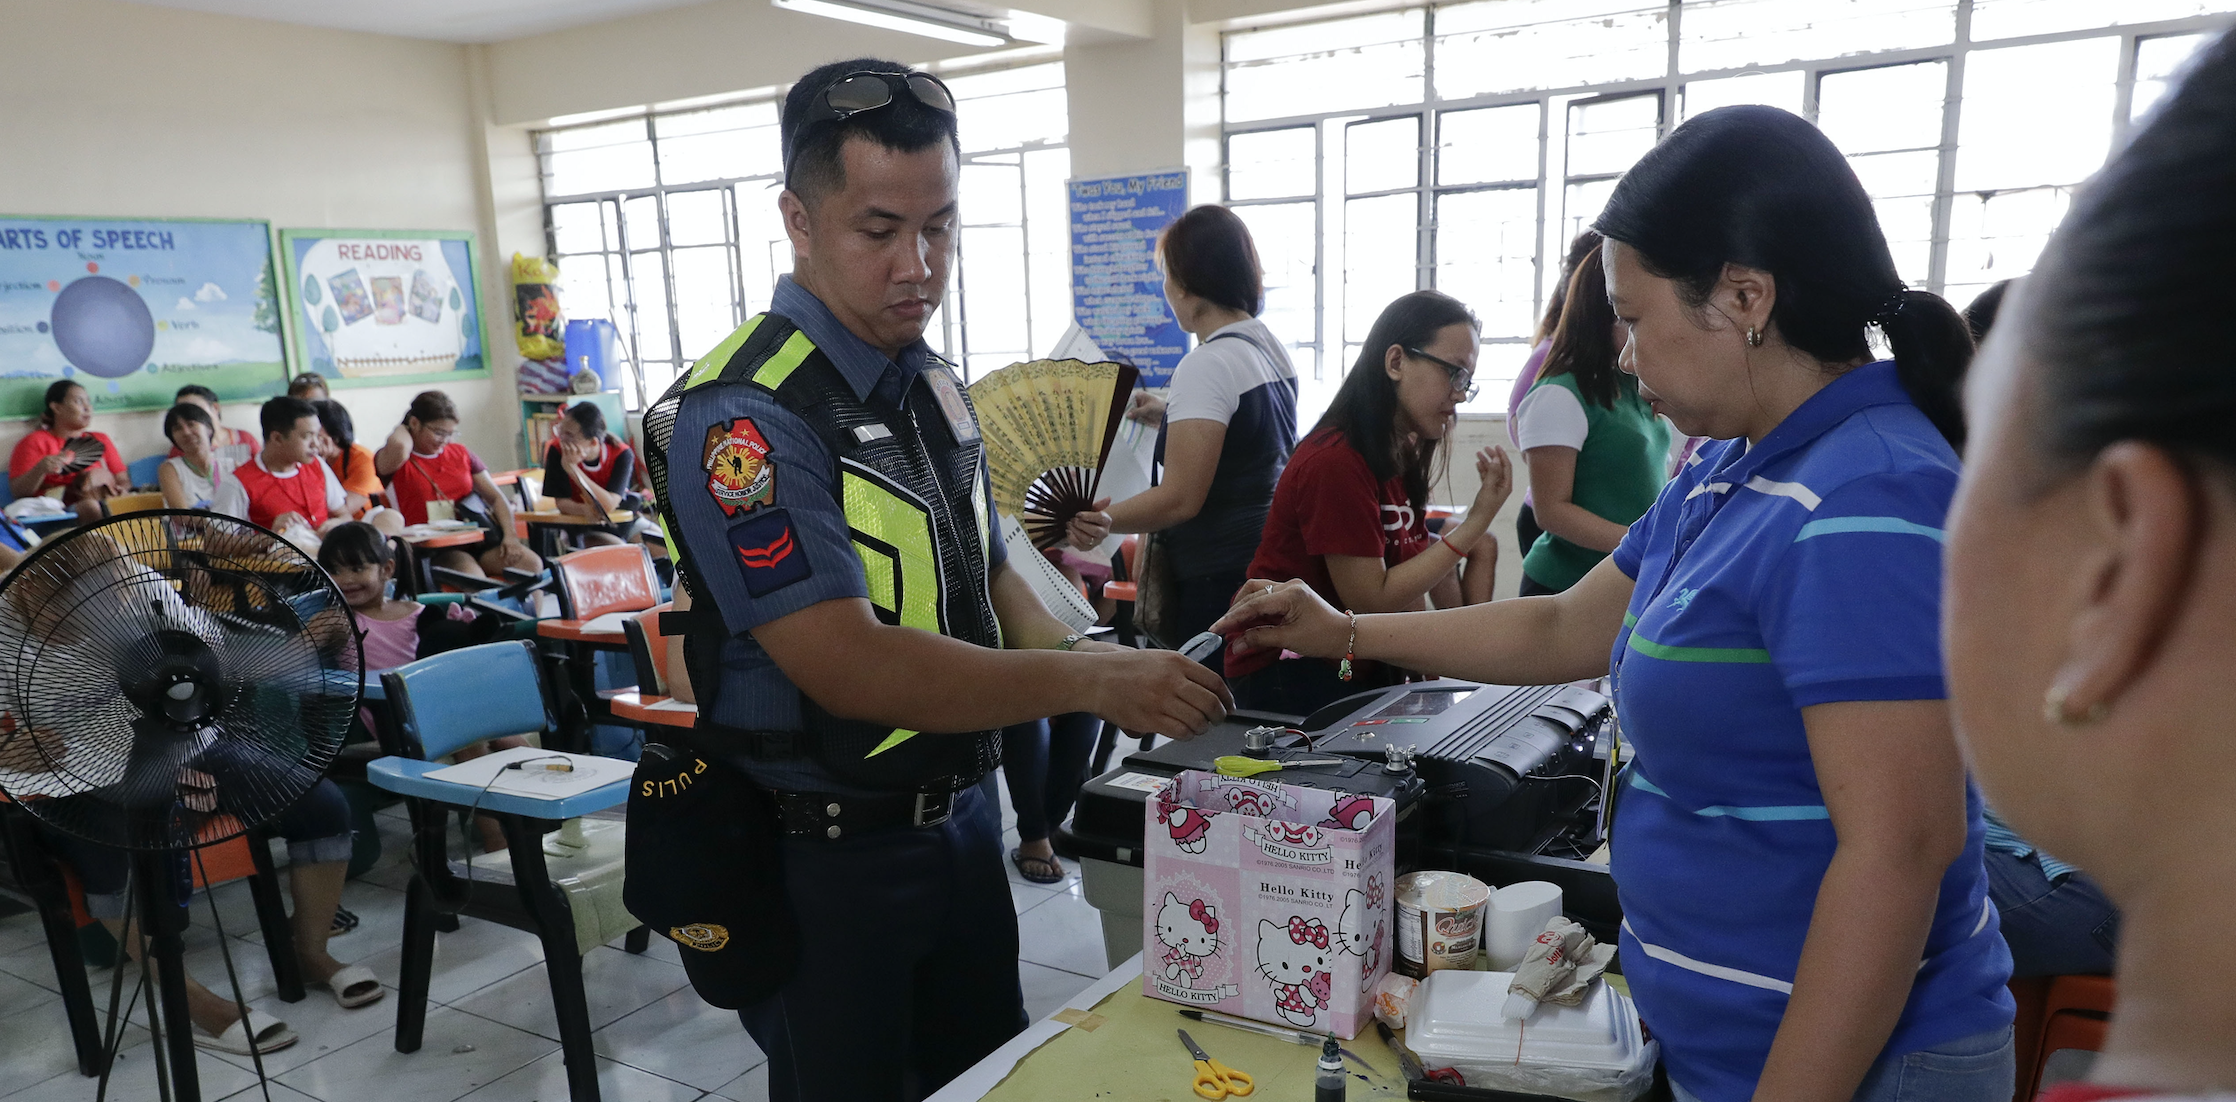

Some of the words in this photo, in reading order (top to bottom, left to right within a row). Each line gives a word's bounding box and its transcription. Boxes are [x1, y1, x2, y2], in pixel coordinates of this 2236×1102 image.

[1127, 177, 1146, 196] My
[1146, 174, 1184, 192] Friend
[57, 229, 83, 250] OF
[92, 229, 175, 250] SPEECH
[338, 243, 422, 261] READING
[722, 437, 749, 447] NATIONAL
[641, 758, 708, 798] PULIS
[1264, 843, 1297, 859] HELLO
[1299, 852, 1329, 861] KITTY
[1274, 861, 1288, 869] 2005
[1288, 863, 1311, 872] SANRIO
[1260, 882, 1294, 896] Hello
[1300, 888, 1334, 902] Kitty
[1276, 895, 1290, 903] 2005
[1290, 898, 1314, 907] SANRIO
[1160, 983, 1188, 998] HELLO
[1191, 992, 1217, 1001] KITTY
